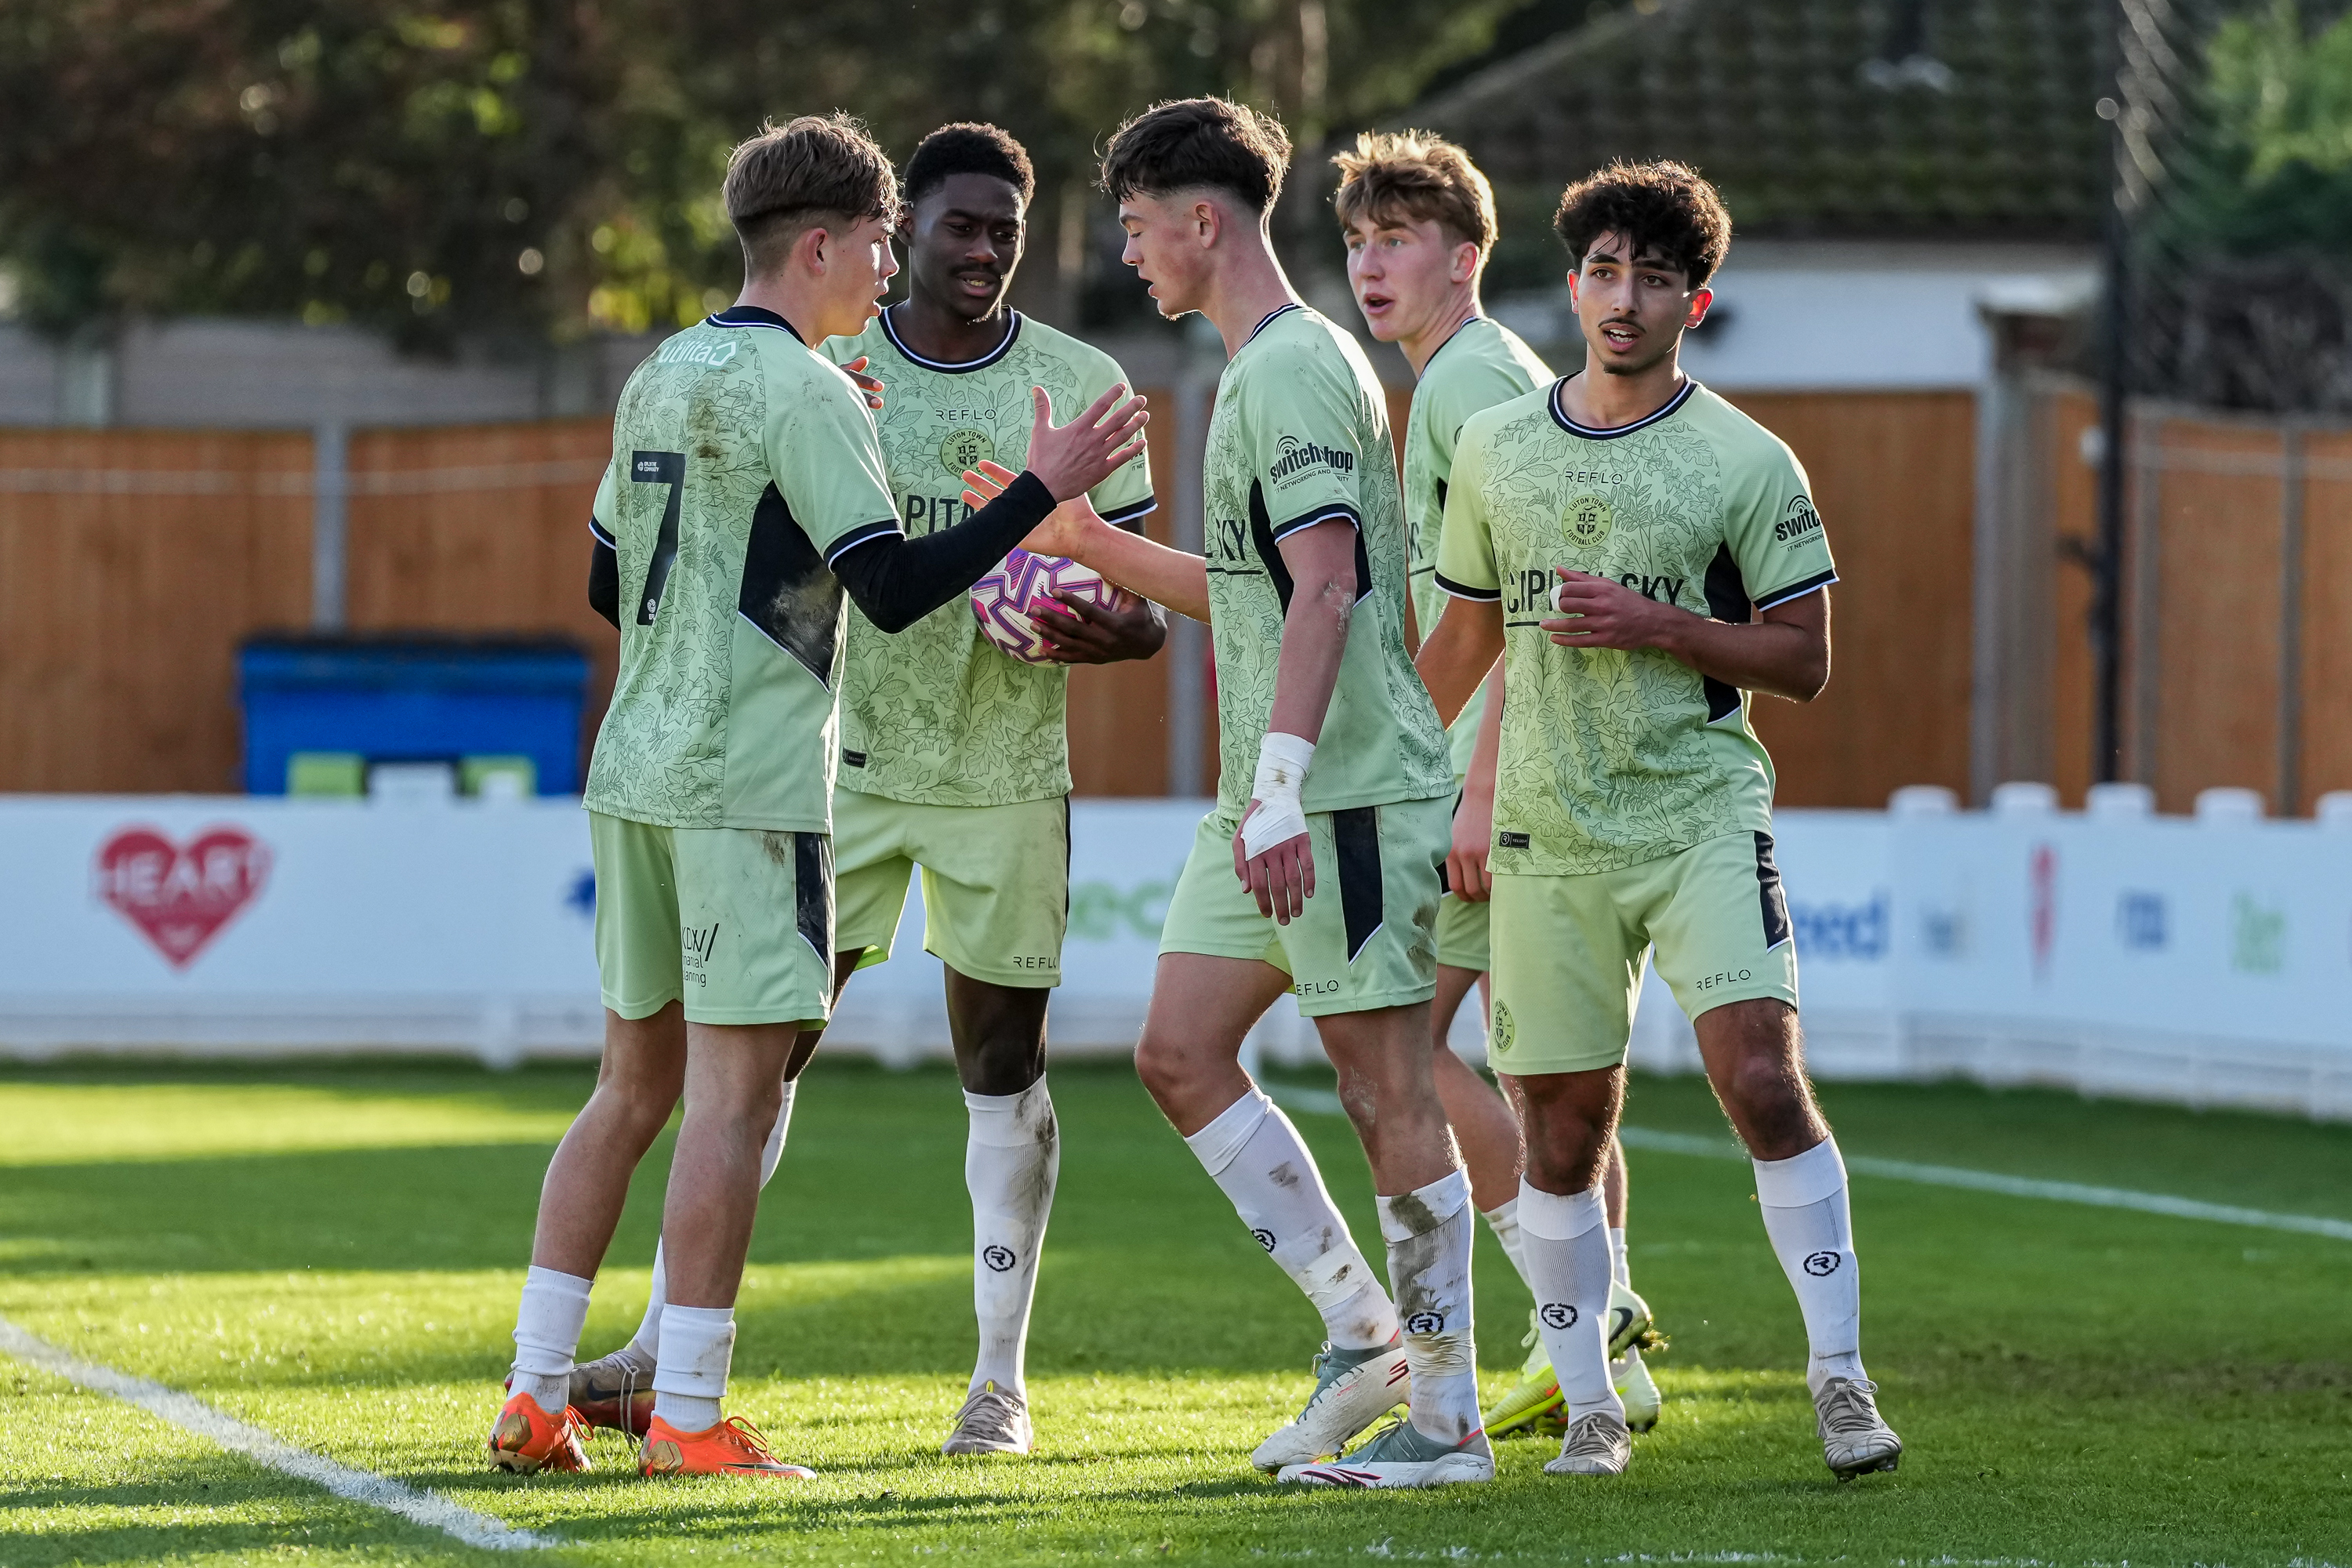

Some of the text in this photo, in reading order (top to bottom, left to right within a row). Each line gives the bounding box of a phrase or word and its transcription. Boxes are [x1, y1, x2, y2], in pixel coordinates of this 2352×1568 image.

[658, 340, 713, 364] utilita
[935, 408, 996, 420] REFLO
[946, 430, 987, 445] LUTON TOWN
[1279, 471, 1316, 491] NETWORKING
[1565, 471, 1623, 485] REFLO
[1569, 497, 1607, 513] LUTON TOWN
[630, 450, 686, 625] 7
[1566, 529, 1605, 545] FOOTBALL CLUB
[1696, 969, 1751, 991] REFLO
